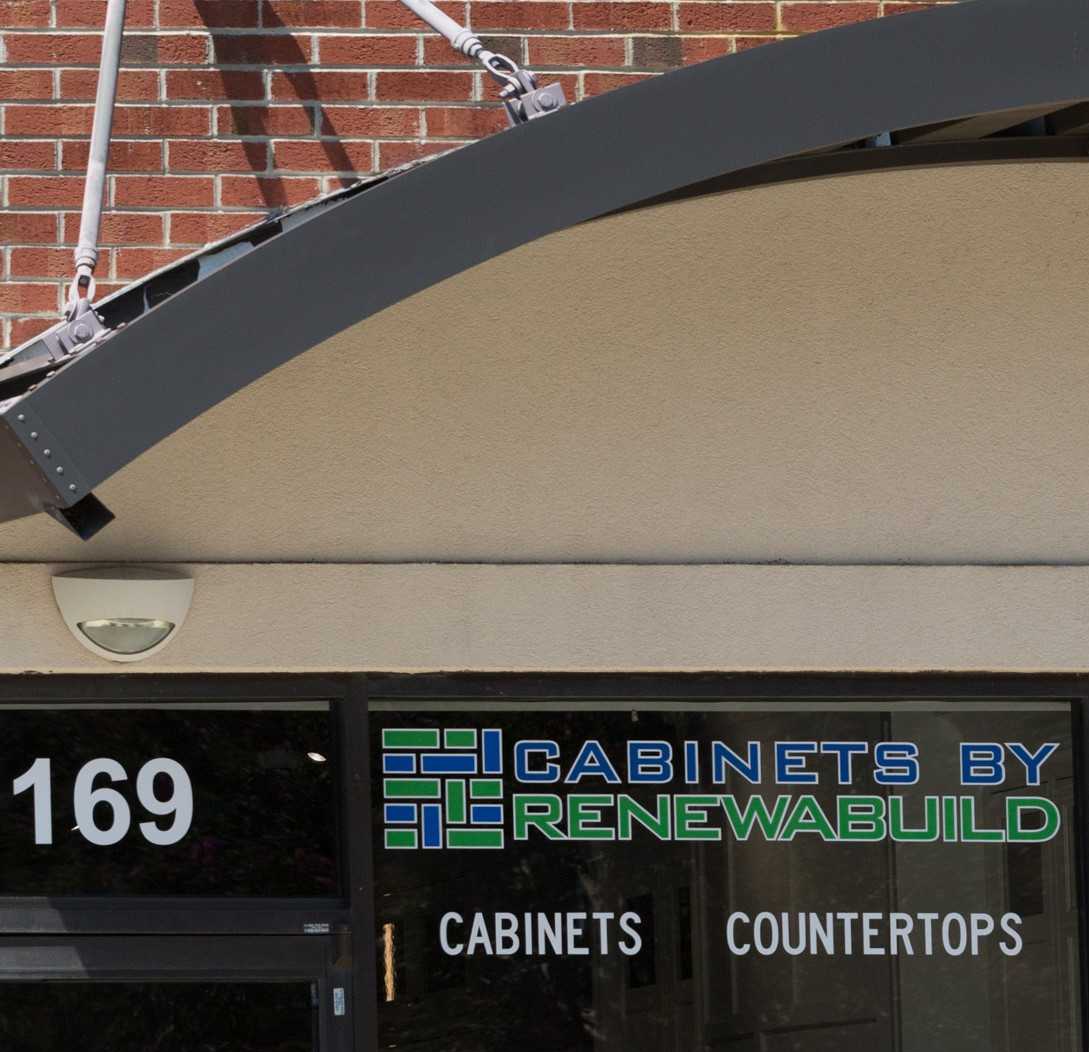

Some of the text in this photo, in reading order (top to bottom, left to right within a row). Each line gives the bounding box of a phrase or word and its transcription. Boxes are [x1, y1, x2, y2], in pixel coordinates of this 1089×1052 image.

[514, 740, 1060, 786] CABINETS BY
[13, 757, 194, 846] 169
[512, 793, 1061, 842] RENEWABUILD
[439, 911, 1023, 956] CABINETS COUNTERTOPS
